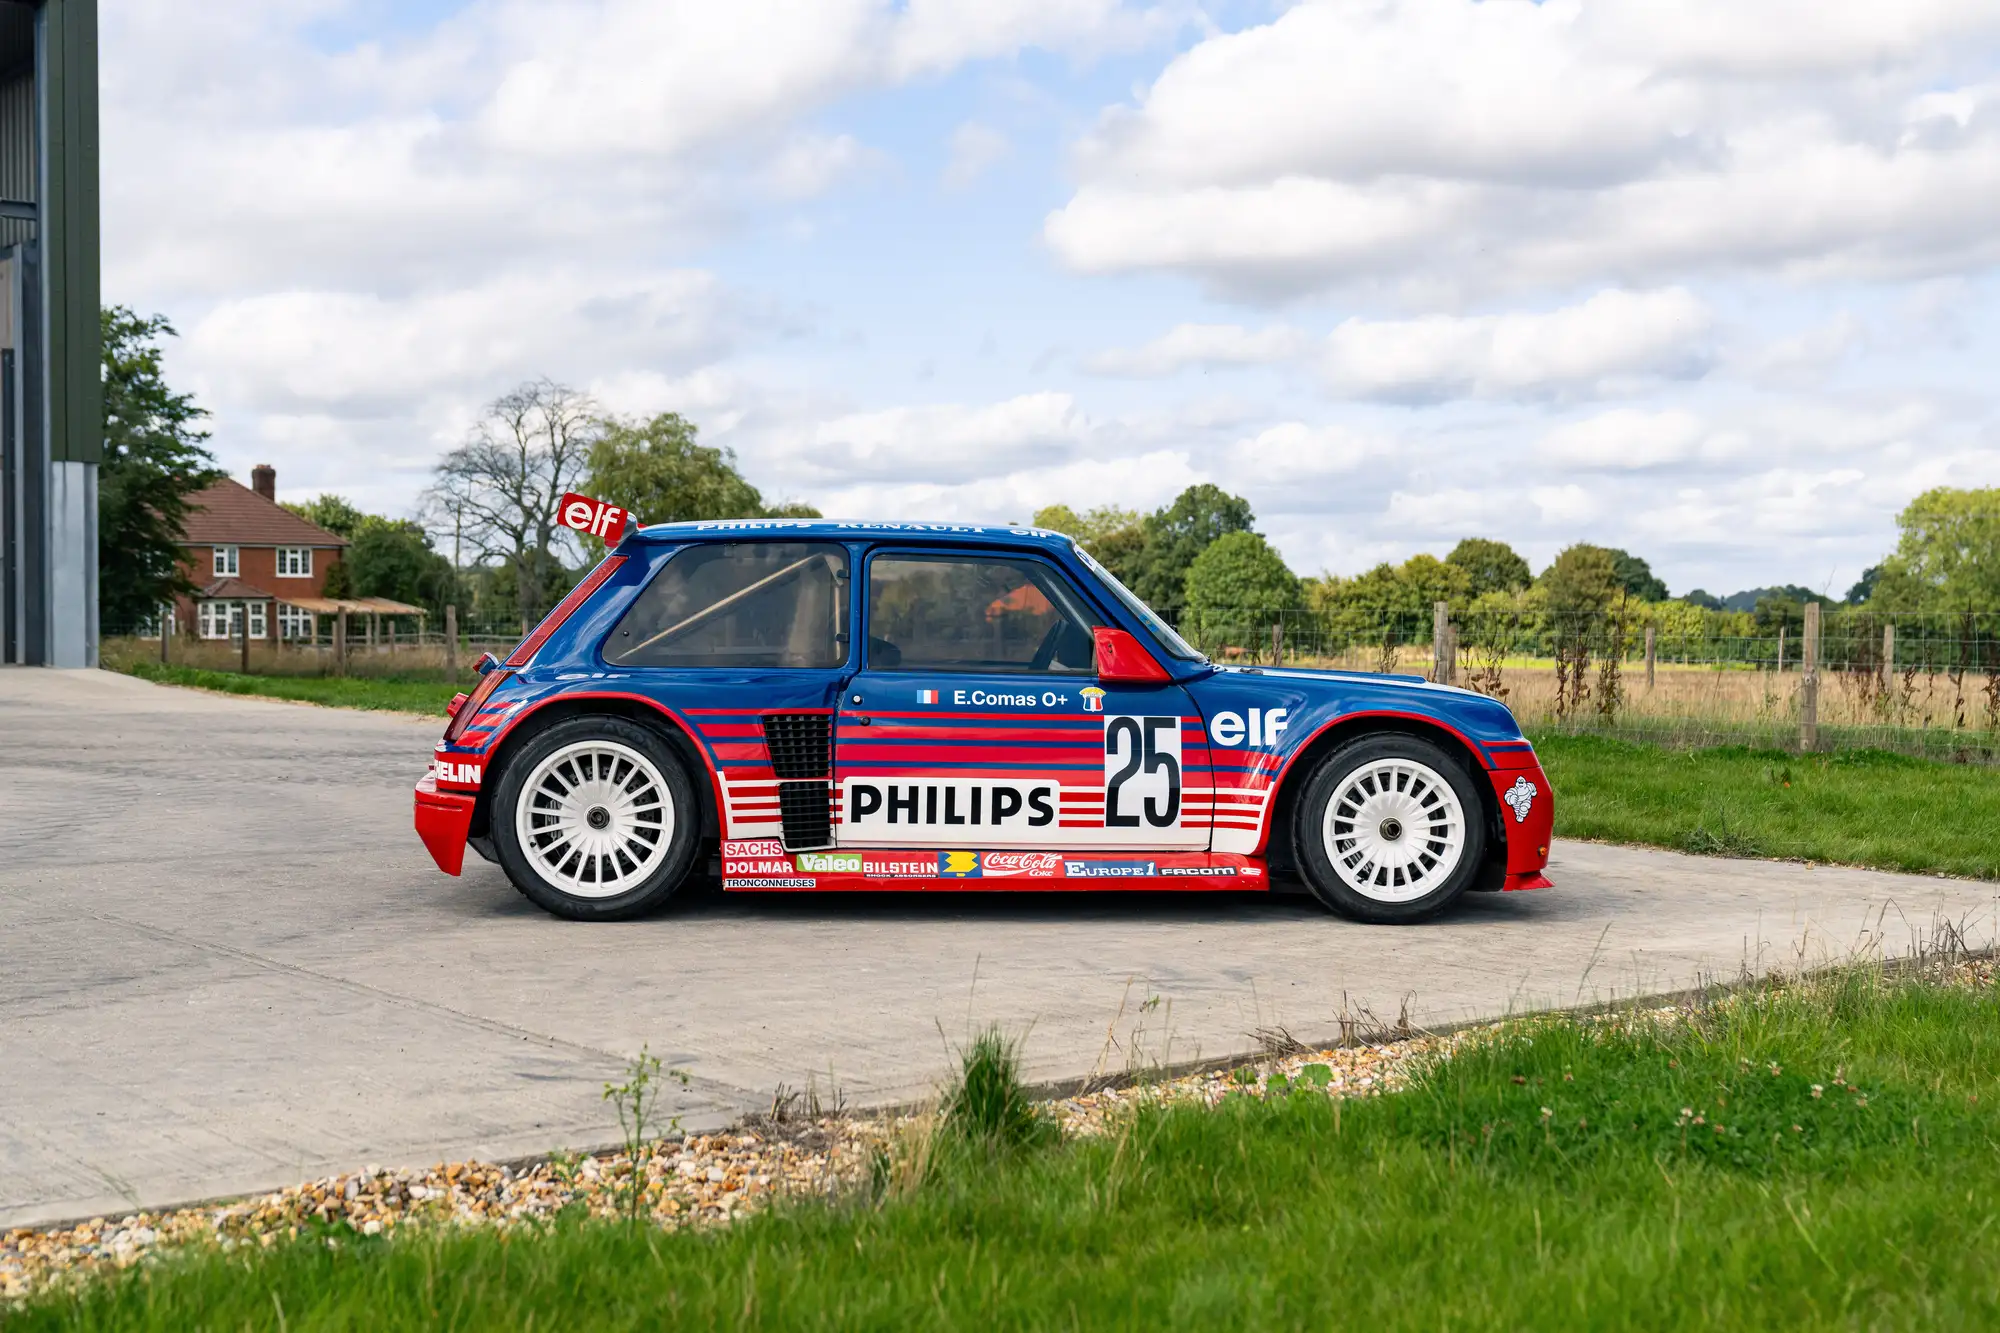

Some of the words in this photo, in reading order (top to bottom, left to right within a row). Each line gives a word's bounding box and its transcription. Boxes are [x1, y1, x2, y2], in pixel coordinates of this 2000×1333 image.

[565, 501, 621, 538] elf
[953, 690, 1036, 706] E.Comas
[1041, 692, 1068, 707] O+
[1210, 708, 1288, 746] elf
[1105, 716, 1180, 828] 25
[850, 784, 1054, 827] PHILIPS
[725, 843, 781, 856] SACHS
[725, 861, 793, 874] DOLMAR
[800, 853, 860, 872] Valeo
[863, 862, 938, 874] BILSTEIN
[984, 852, 1061, 869] Coca-Cola
[725, 878, 815, 887] TRONCONNEUSES
